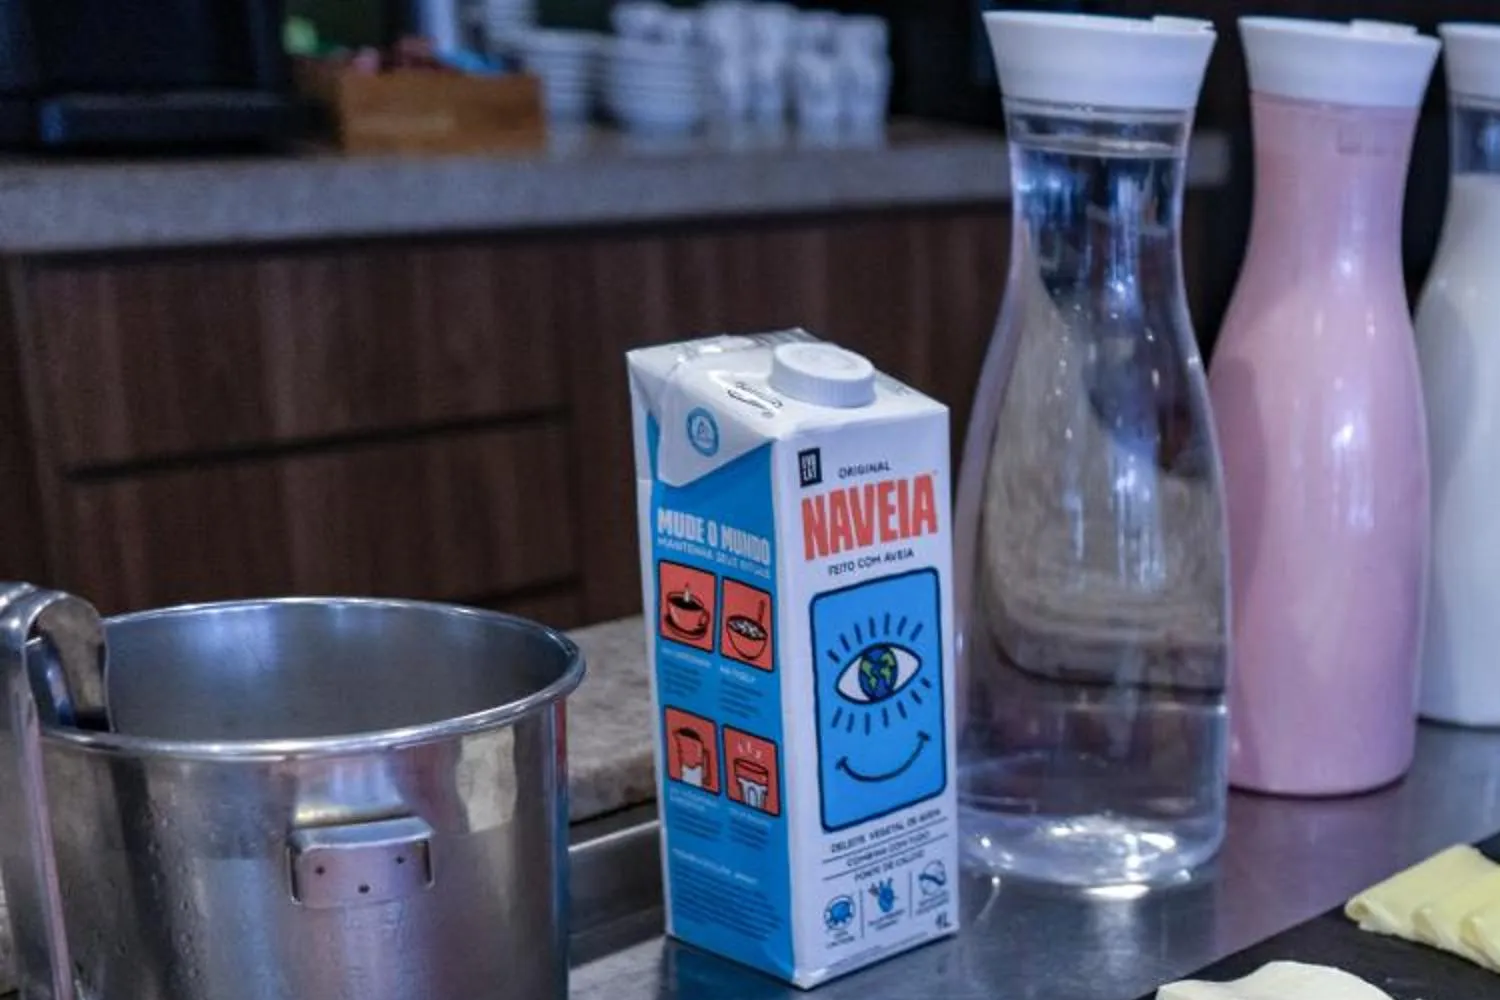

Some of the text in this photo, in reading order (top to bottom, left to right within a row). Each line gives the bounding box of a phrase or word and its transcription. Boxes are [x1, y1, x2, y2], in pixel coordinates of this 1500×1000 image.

[837, 460, 891, 480] ORIGINAL
[657, 507, 770, 566] MUDE O MUNDO
[802, 475, 938, 561] NAVEIA
[827, 548, 914, 576] FEITO COM AVEIA
